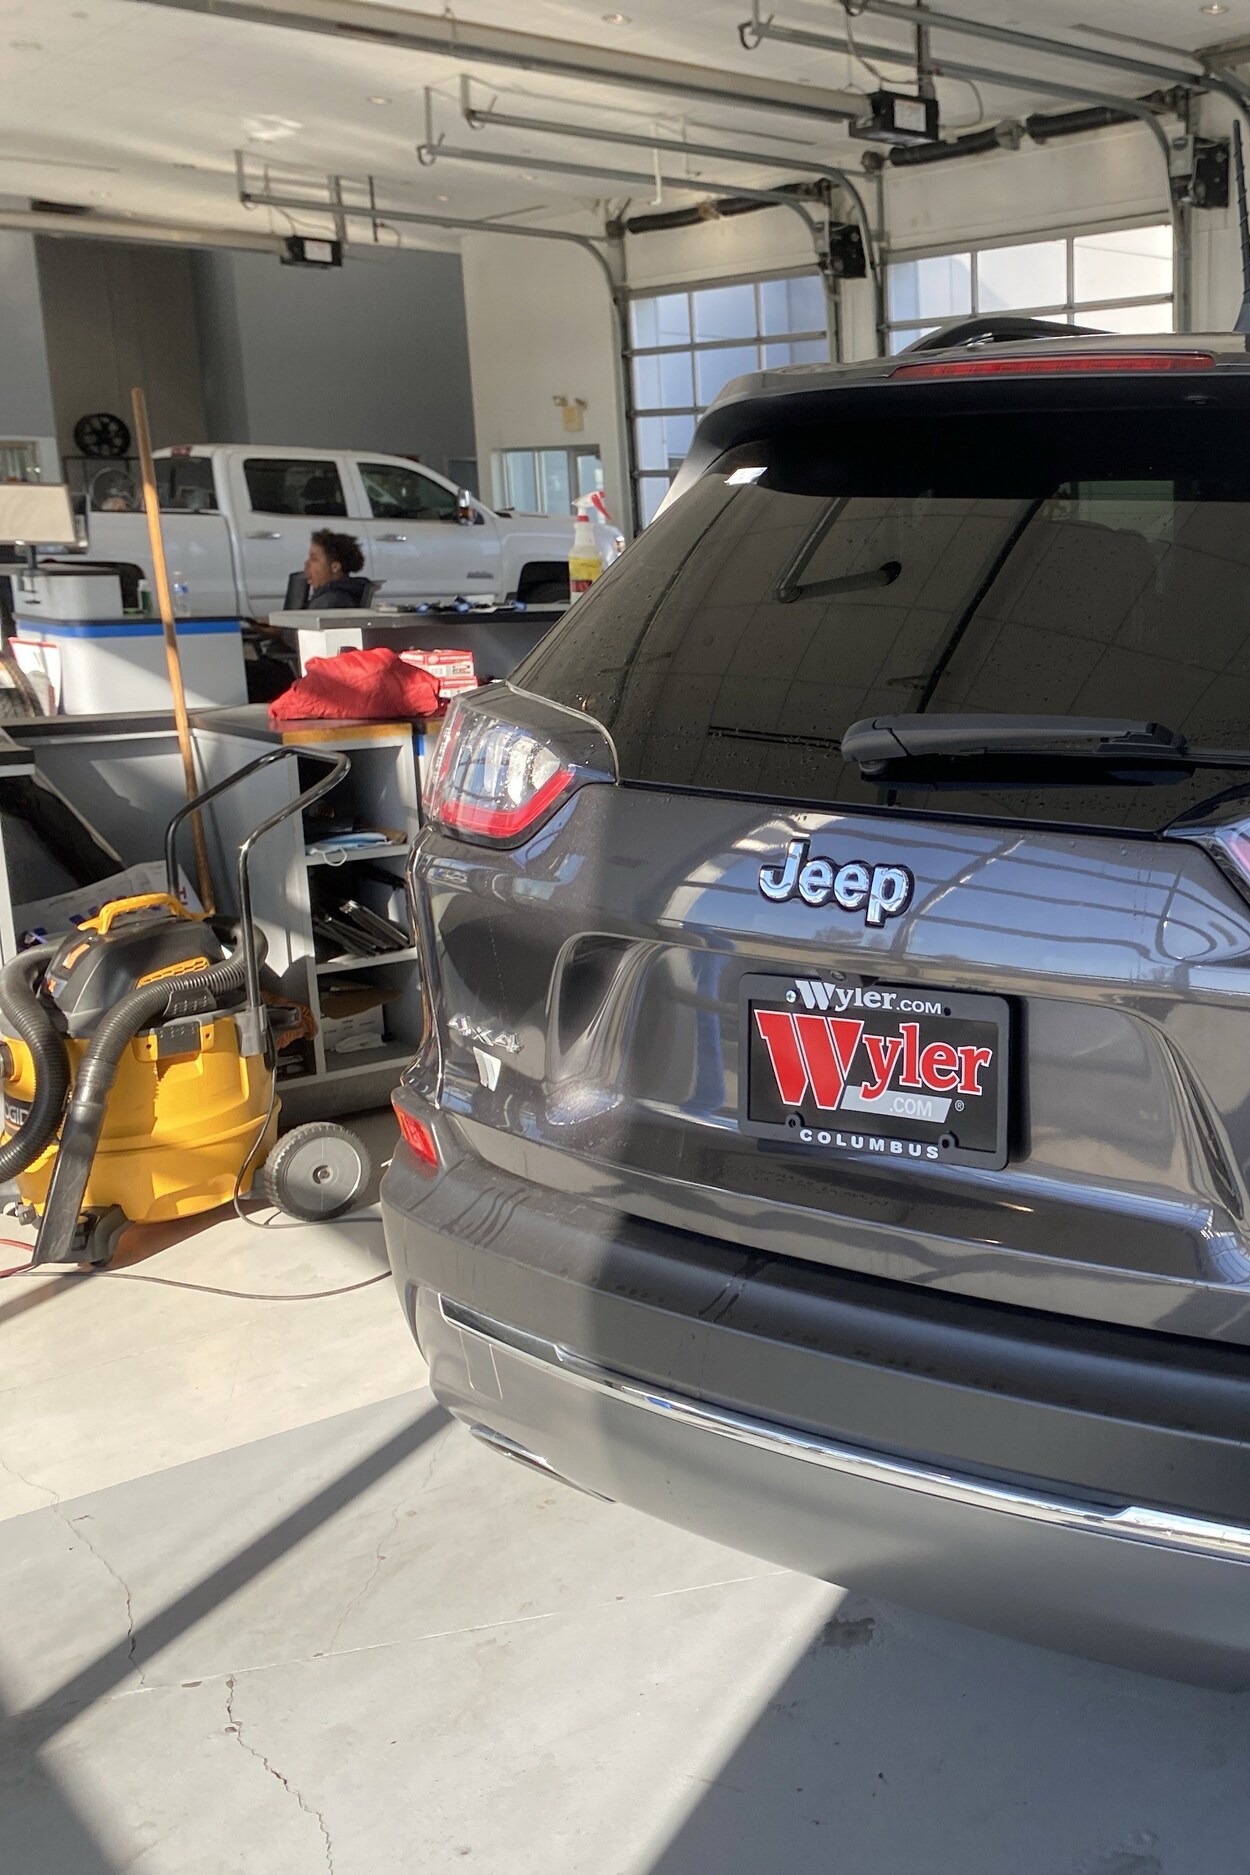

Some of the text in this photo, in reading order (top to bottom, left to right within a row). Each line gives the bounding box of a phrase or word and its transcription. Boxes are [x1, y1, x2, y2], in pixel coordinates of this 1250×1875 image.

[758, 838, 914, 927] Jeep
[755, 1009, 993, 1110] Wyler
[889, 1097, 933, 1118] .COM
[800, 1129, 940, 1159] COLUMBUS
